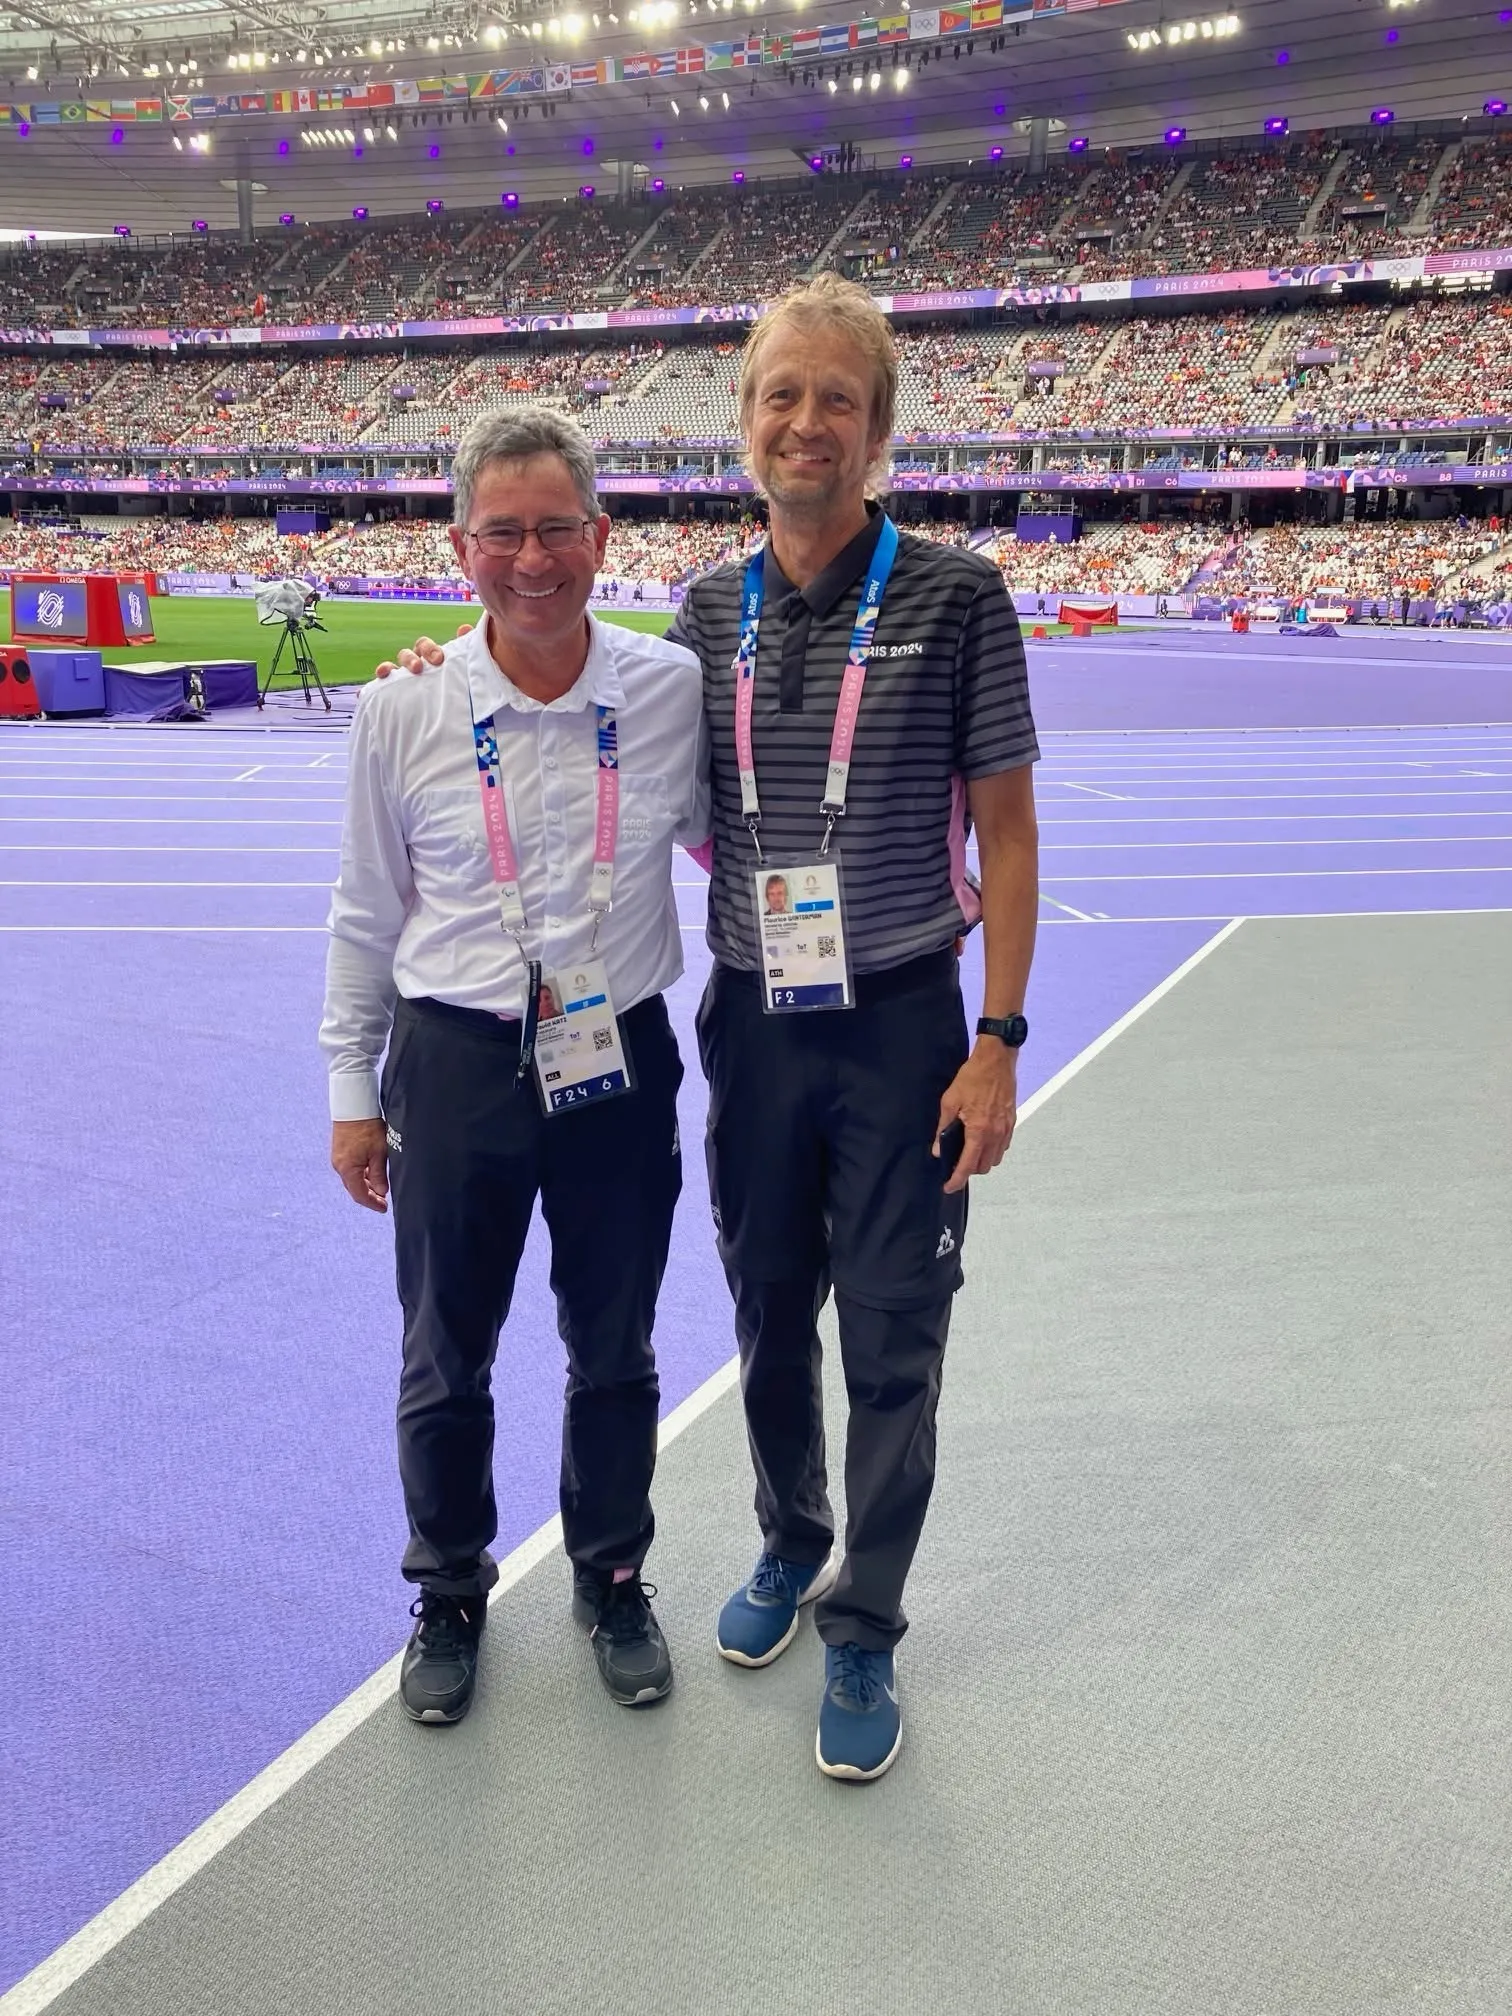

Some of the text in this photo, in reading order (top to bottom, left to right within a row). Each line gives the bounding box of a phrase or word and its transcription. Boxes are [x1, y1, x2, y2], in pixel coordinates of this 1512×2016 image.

[1452, 257, 1491, 269] PARIS
[1155, 278, 1225, 293] PARIS 2024
[913, 295, 975, 307] PARIS 2024
[625, 312, 677, 322] PARIS 2024
[105, 333, 133, 341] PARIS
[275, 329, 321, 338] PARIS 2024
[1211, 474, 1241, 484] PARIS
[1475, 469, 1508, 479] PARIS
[893, 481, 903, 489] D2
[1017, 477, 1042, 486] 2024
[65, 576, 87, 584] OMEGA
[168, 577, 191, 585] PARIS
[866, 579, 880, 604] Atos
[747, 592, 759, 617] Atos
[870, 642, 922, 657] RIS 2024
[837, 673, 859, 757] PARIS 2024
[601, 775, 614, 857] PARIS 2024
[623, 818, 652, 829] PARIS
[488, 793, 511, 877] PARIS 2024
[623, 829, 652, 841] 2024
[785, 991, 795, 1004] 2
[602, 1078, 612, 1091] 6
